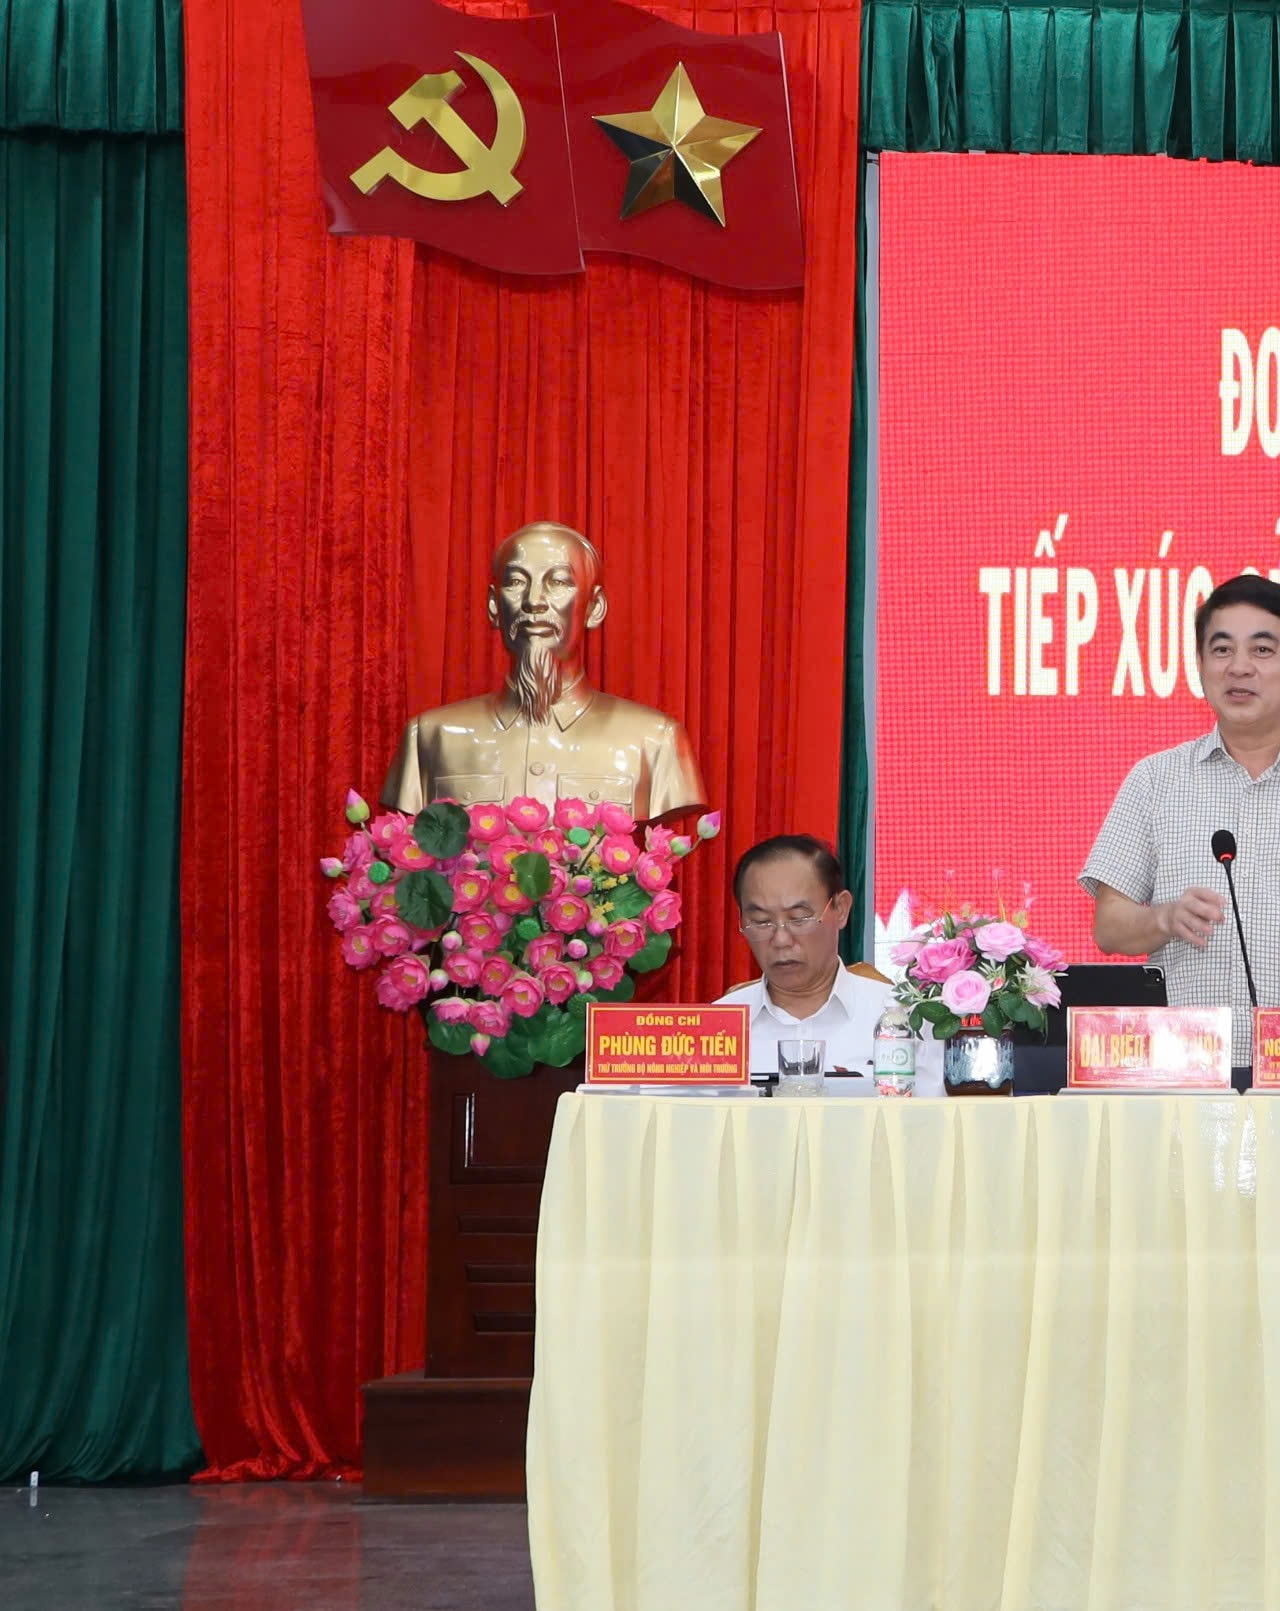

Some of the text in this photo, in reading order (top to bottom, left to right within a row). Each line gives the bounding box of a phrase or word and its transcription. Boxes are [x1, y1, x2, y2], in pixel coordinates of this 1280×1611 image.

[979, 514, 1098, 696] TIẾP
[677, 1014, 701, 1026] CHÍ
[599, 1029, 737, 1056] PHÙNG ĐỨC TIẾN
